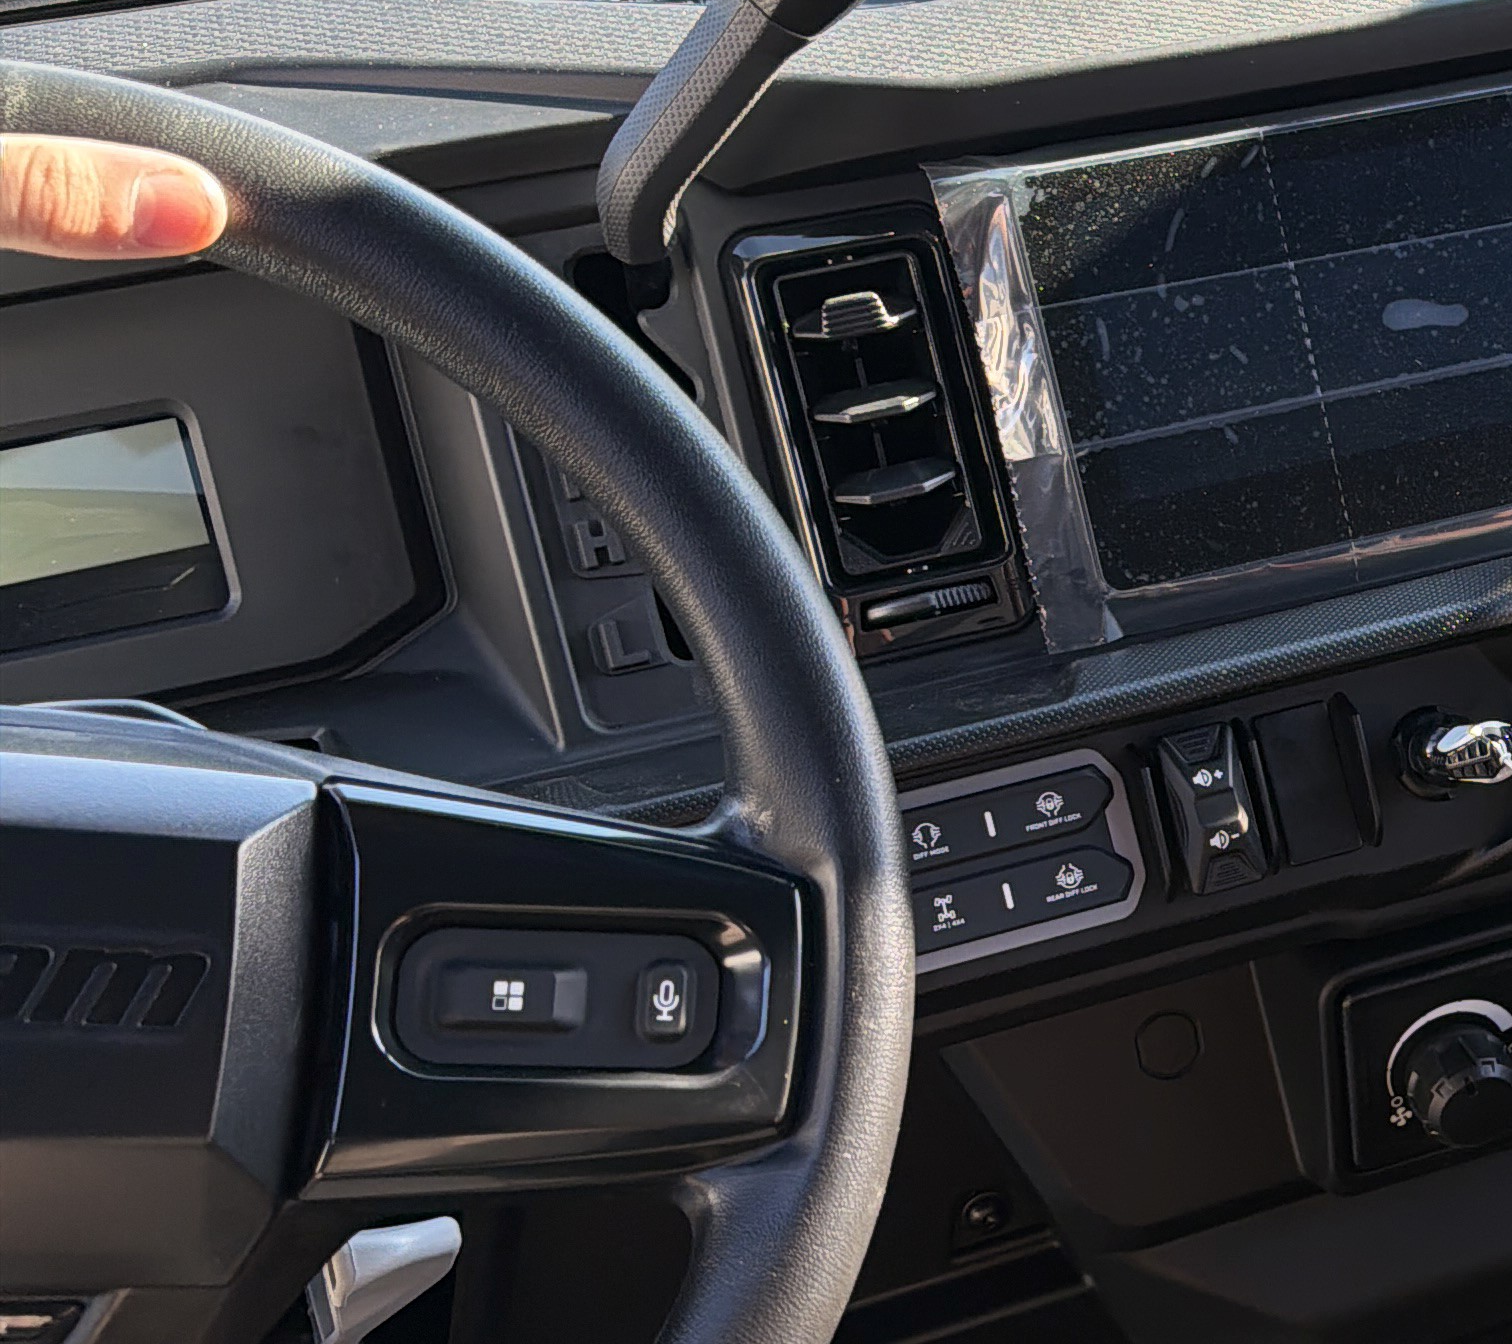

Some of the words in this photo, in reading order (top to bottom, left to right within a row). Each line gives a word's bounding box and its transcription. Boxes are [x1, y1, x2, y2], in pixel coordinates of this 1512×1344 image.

[573, 519, 625, 570] H
[600, 619, 650, 672] L
[1025, 820, 1048, 832] FRONT
[1048, 816, 1063, 827] DIFF
[1064, 813, 1082, 823] LOCK
[913, 851, 929, 860] DIFF
[929, 846, 950, 856] MODE
[1046, 892, 1065, 903] REAR
[1065, 888, 1080, 899] DIFF
[1080, 884, 1098, 894] LOCK
